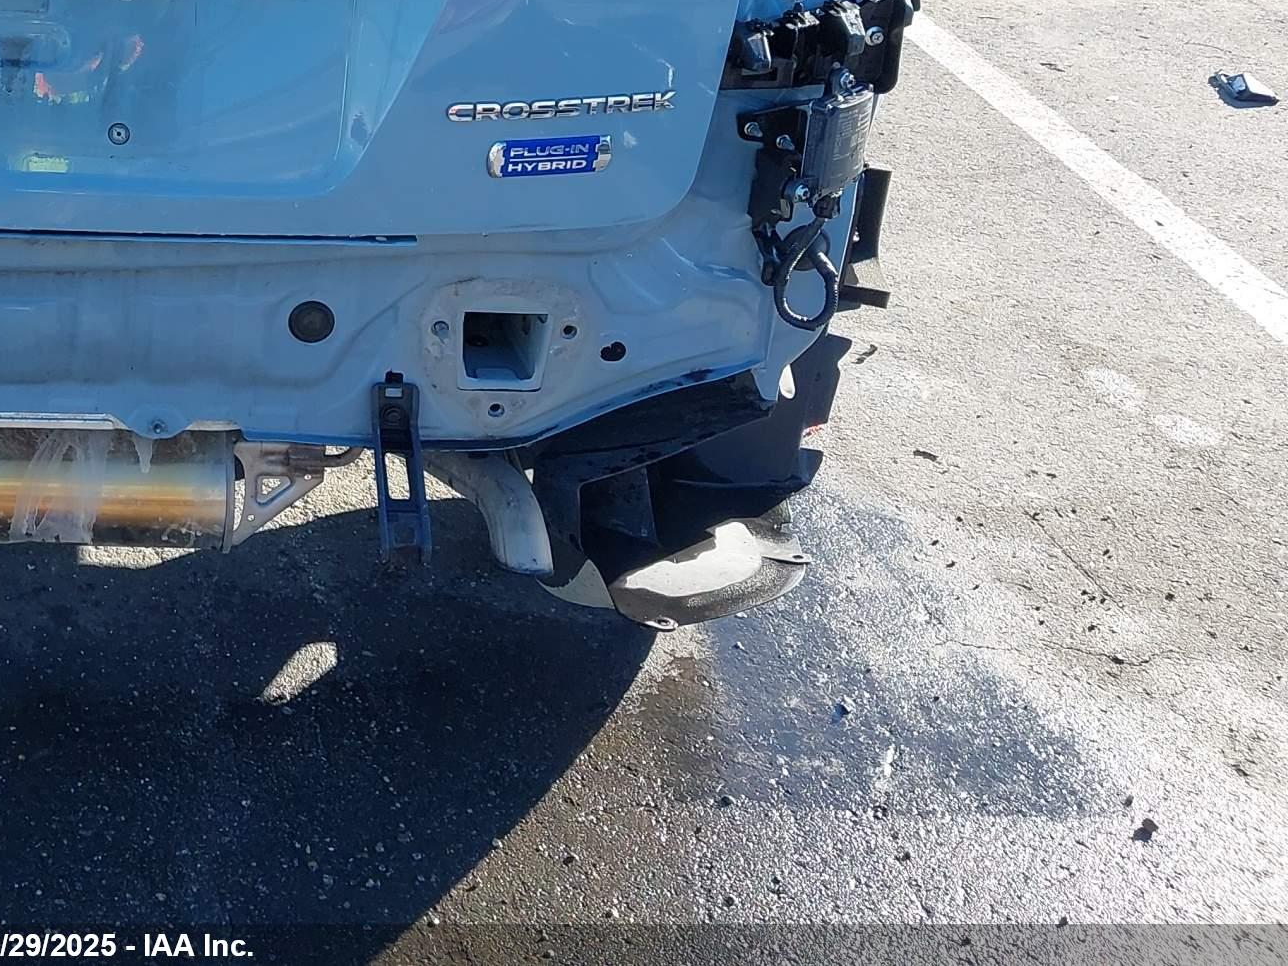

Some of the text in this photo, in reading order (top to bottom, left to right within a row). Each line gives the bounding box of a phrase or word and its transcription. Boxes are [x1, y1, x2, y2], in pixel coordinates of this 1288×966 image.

[446, 90, 677, 122] CROSSTREK
[509, 143, 590, 157] PLUG-IN
[507, 159, 587, 172] HYBRID
